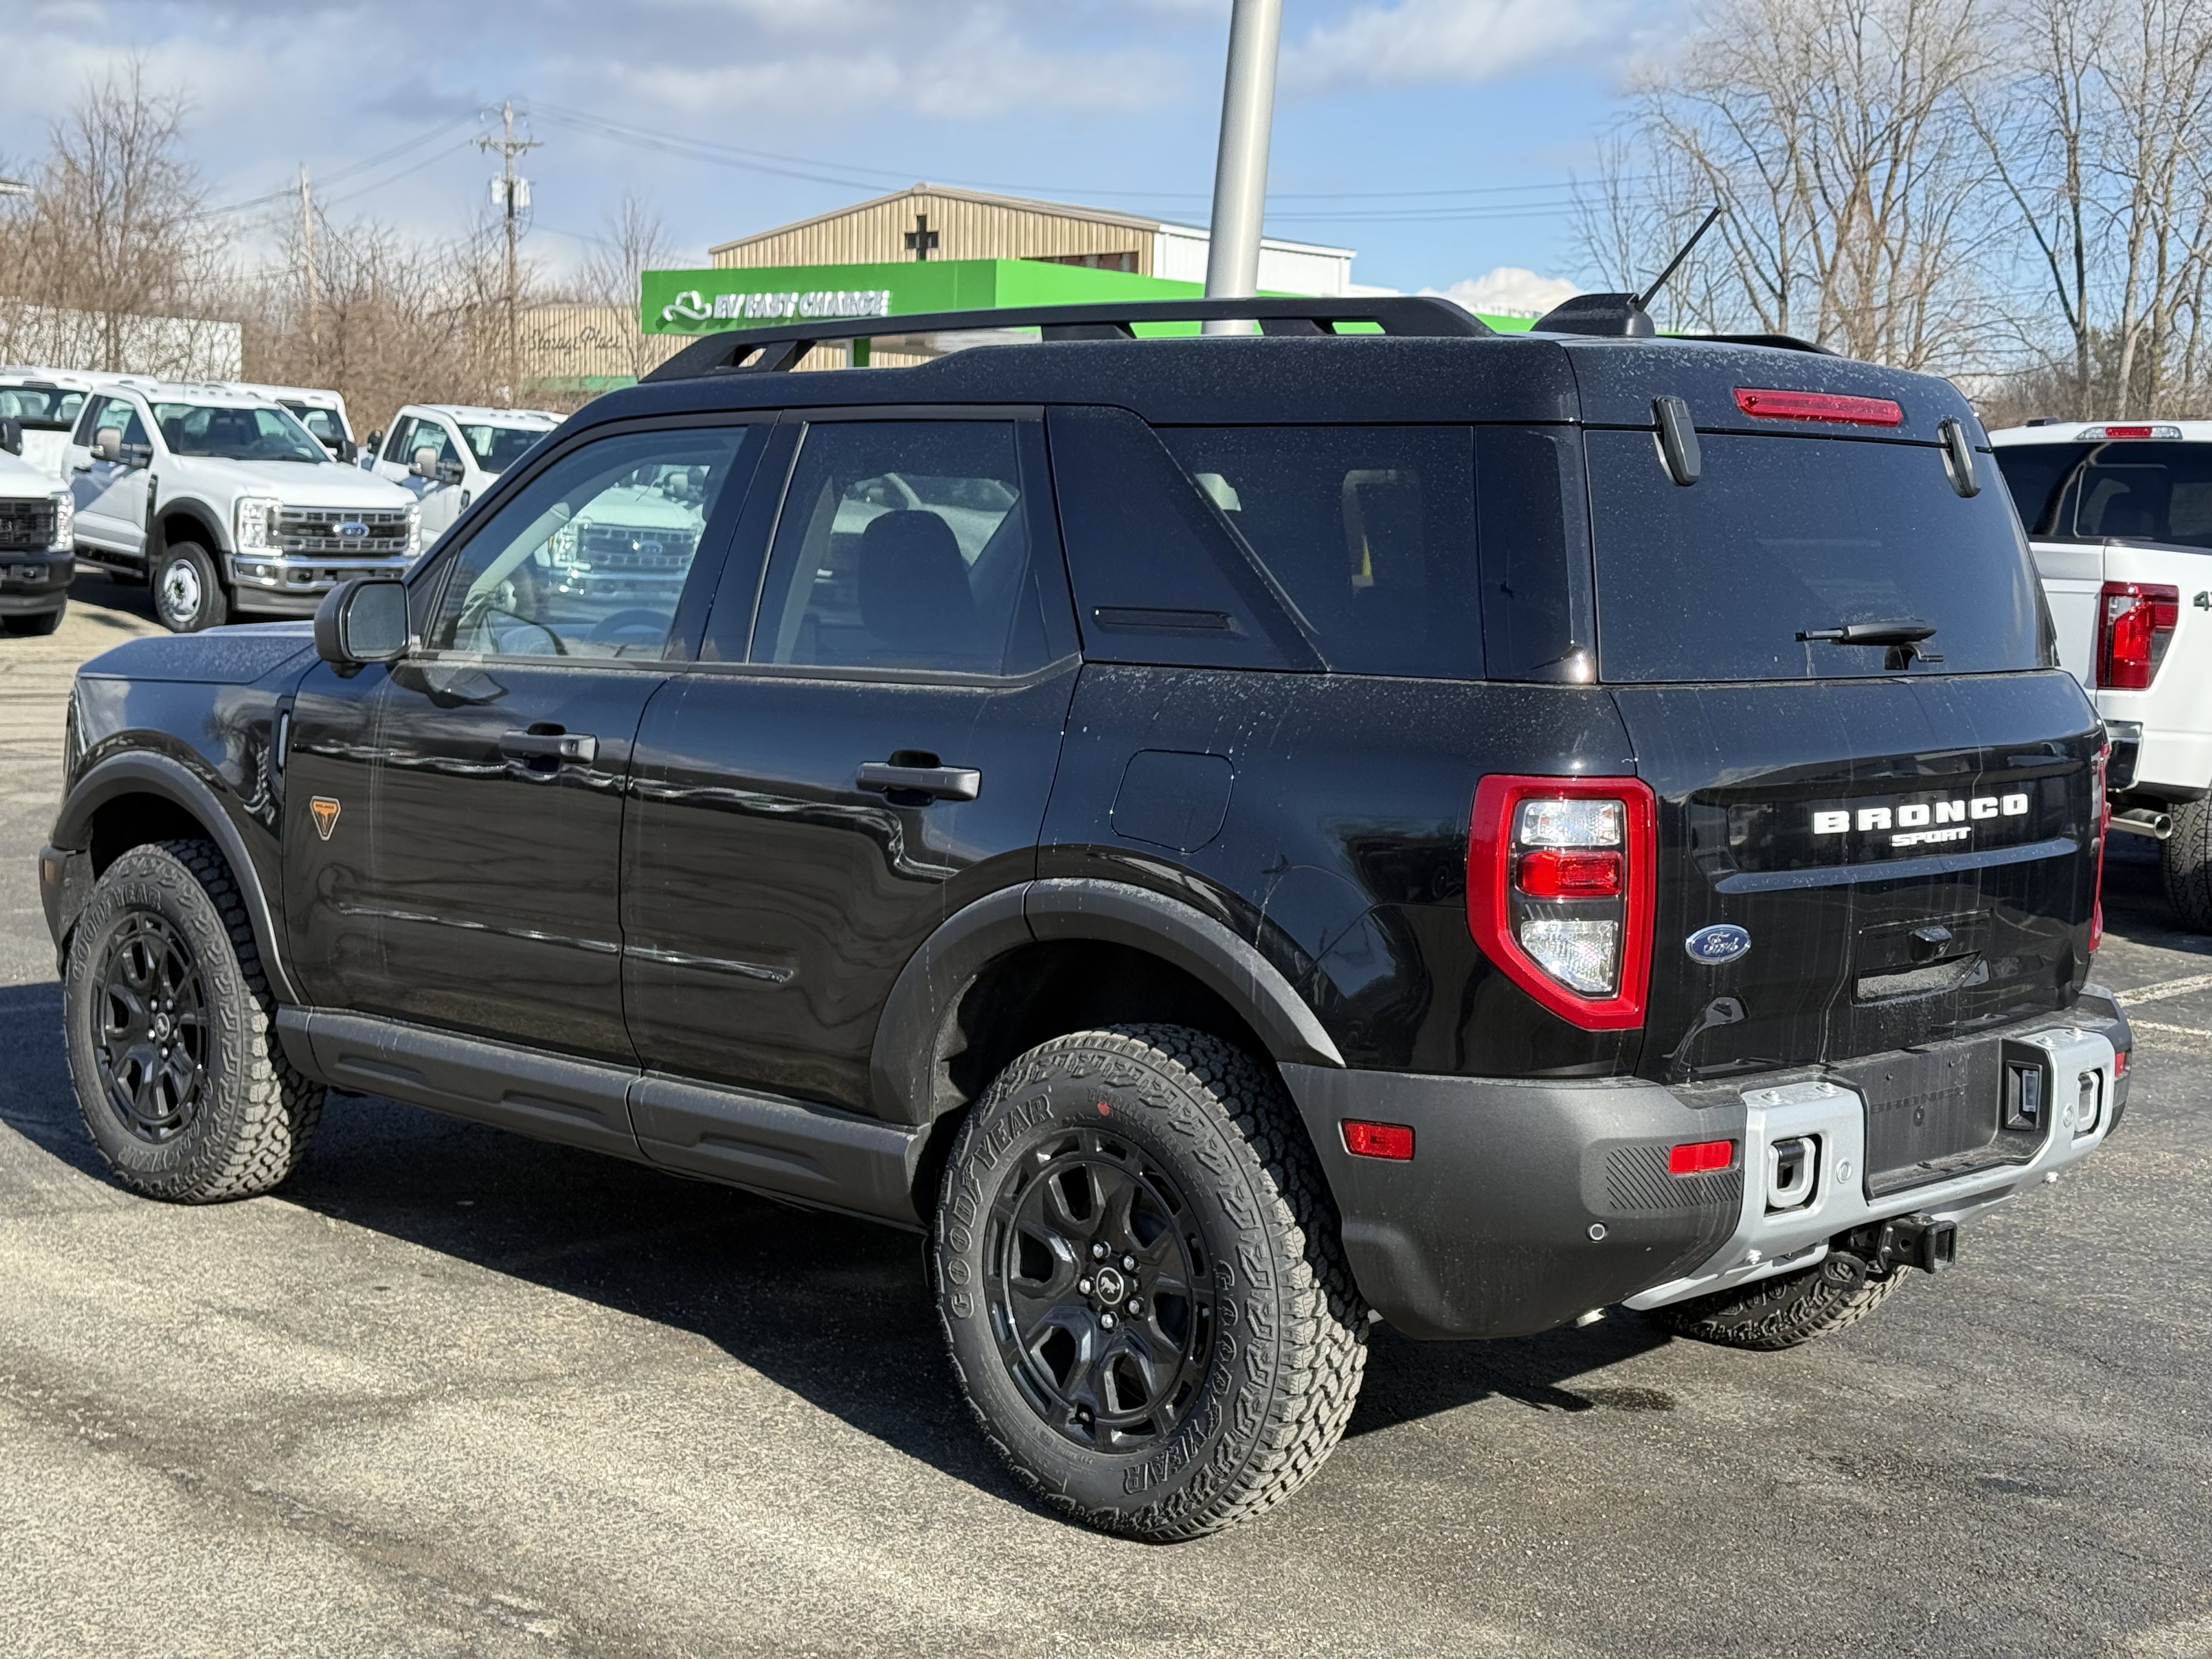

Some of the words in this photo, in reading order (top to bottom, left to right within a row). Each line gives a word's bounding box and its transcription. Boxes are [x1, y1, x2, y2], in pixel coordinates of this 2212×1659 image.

[713, 293, 746, 319] EV
[744, 292, 799, 318] FAST
[799, 290, 890, 317] CHARGE
[1813, 793, 2028, 834] BRONCO
[1891, 827, 1971, 847] SPORT
[1087, 1087, 1188, 1155] TERRITORY
[948, 1093, 1054, 1318] GOODYEAR
[1123, 1259, 1239, 1496] GOODYEAR
